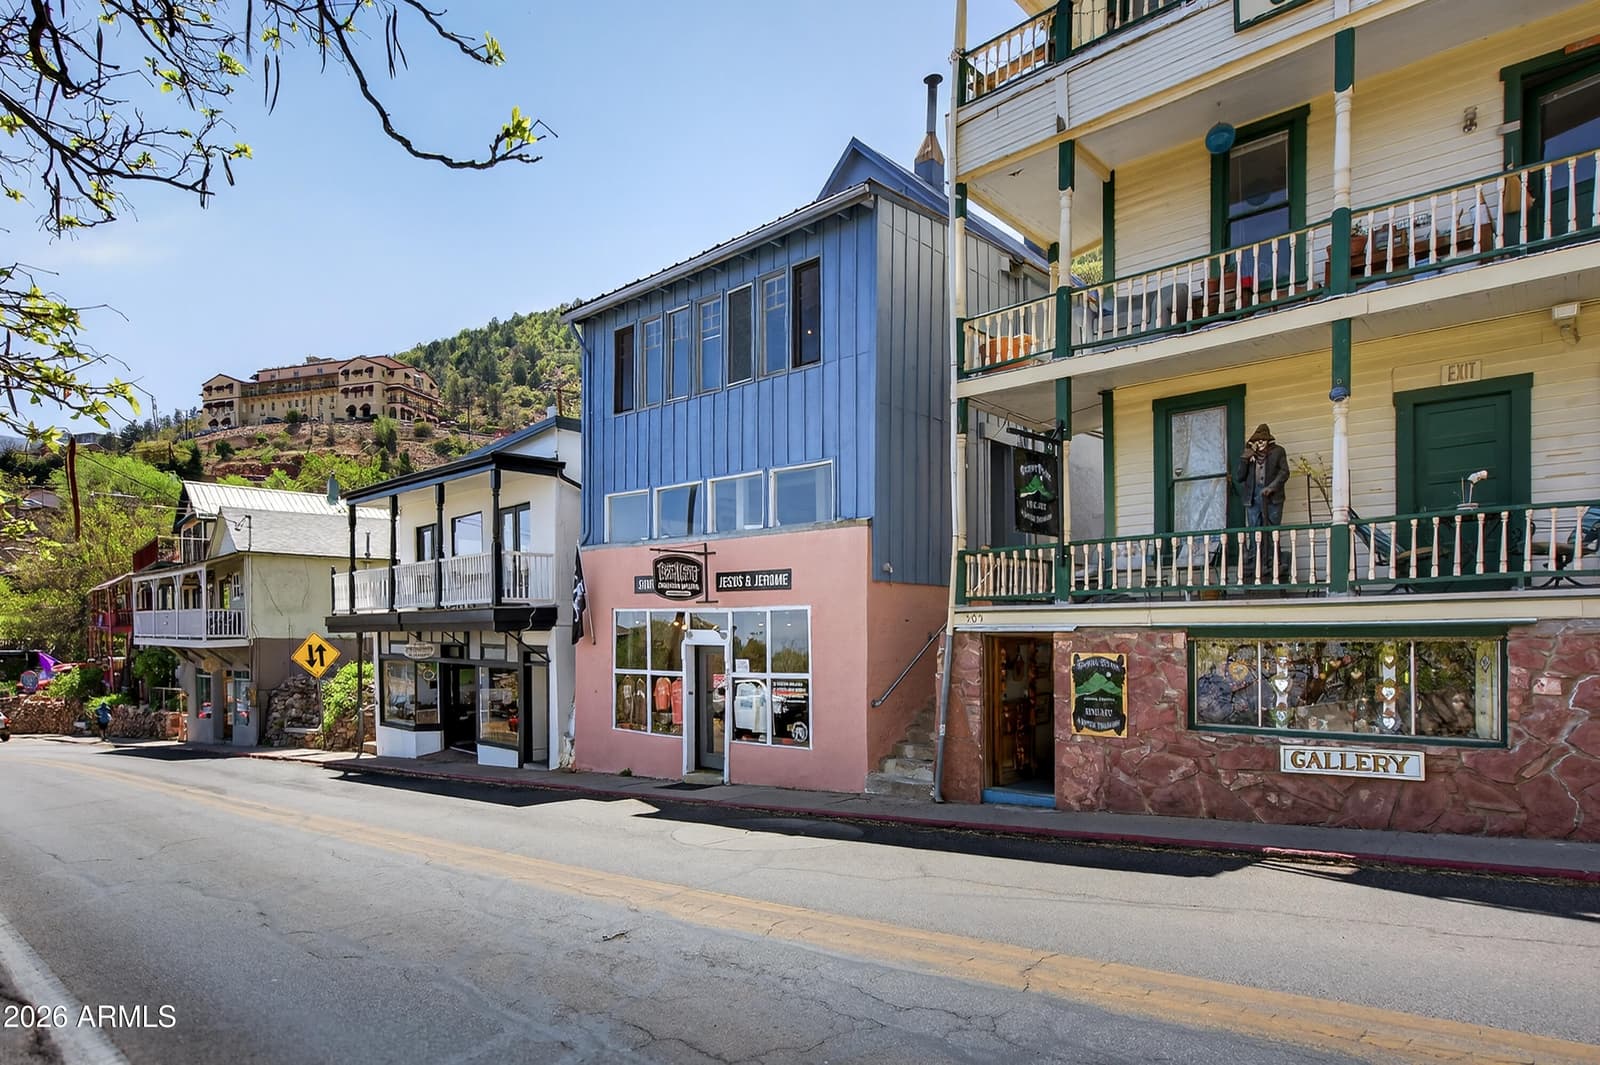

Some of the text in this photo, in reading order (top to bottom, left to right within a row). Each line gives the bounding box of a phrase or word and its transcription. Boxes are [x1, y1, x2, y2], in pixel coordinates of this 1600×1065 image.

[1447, 362, 1476, 382] EXIT
[719, 573, 788, 588] JESUS & JEROME
[1290, 750, 1411, 774] GALLERY
